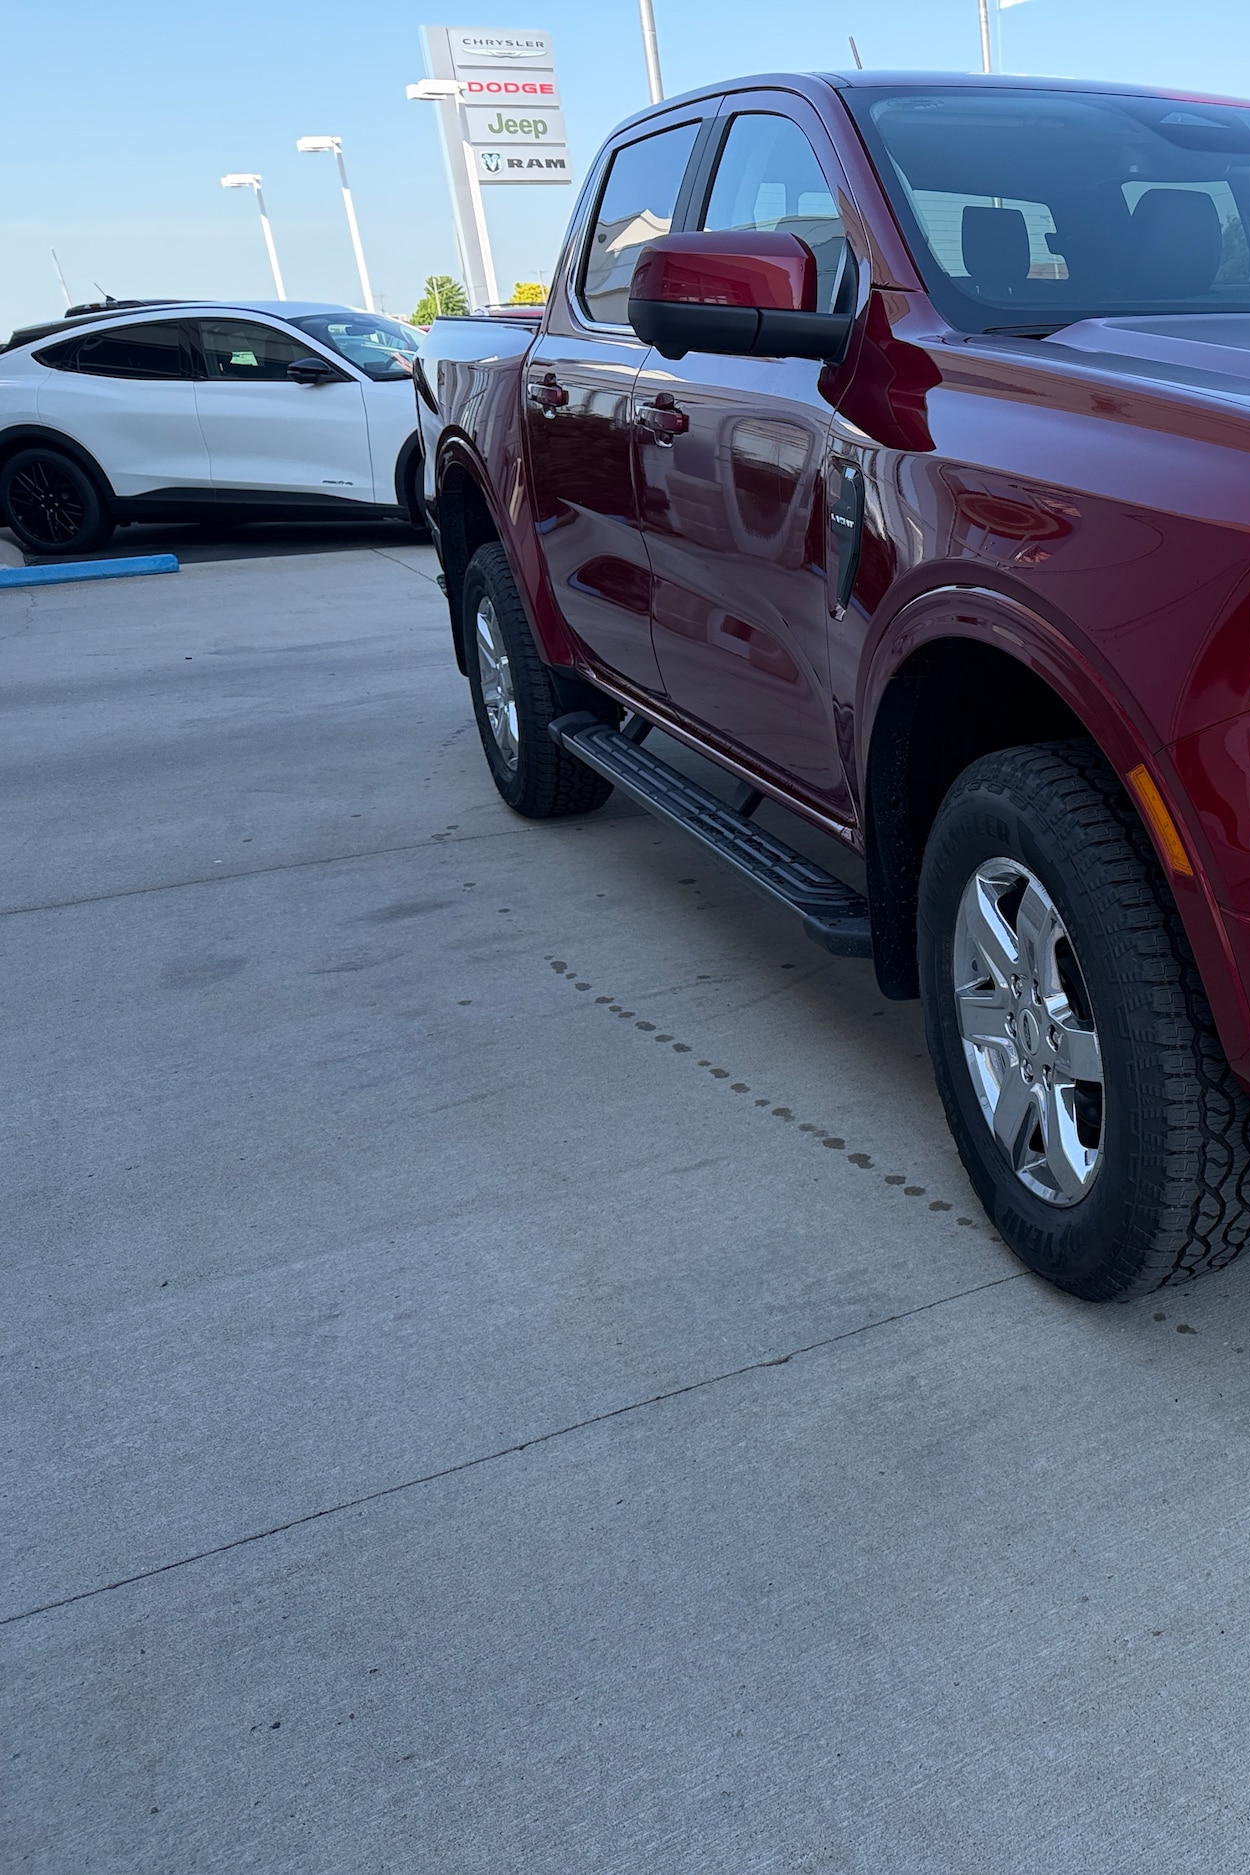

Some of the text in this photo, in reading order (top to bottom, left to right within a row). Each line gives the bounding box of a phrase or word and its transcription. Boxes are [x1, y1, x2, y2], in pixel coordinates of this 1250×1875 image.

[462, 38, 545, 48] CHRYSLER
[467, 81, 555, 95] DODGE
[487, 112, 548, 139] Jeep
[507, 158, 566, 169] RAM
